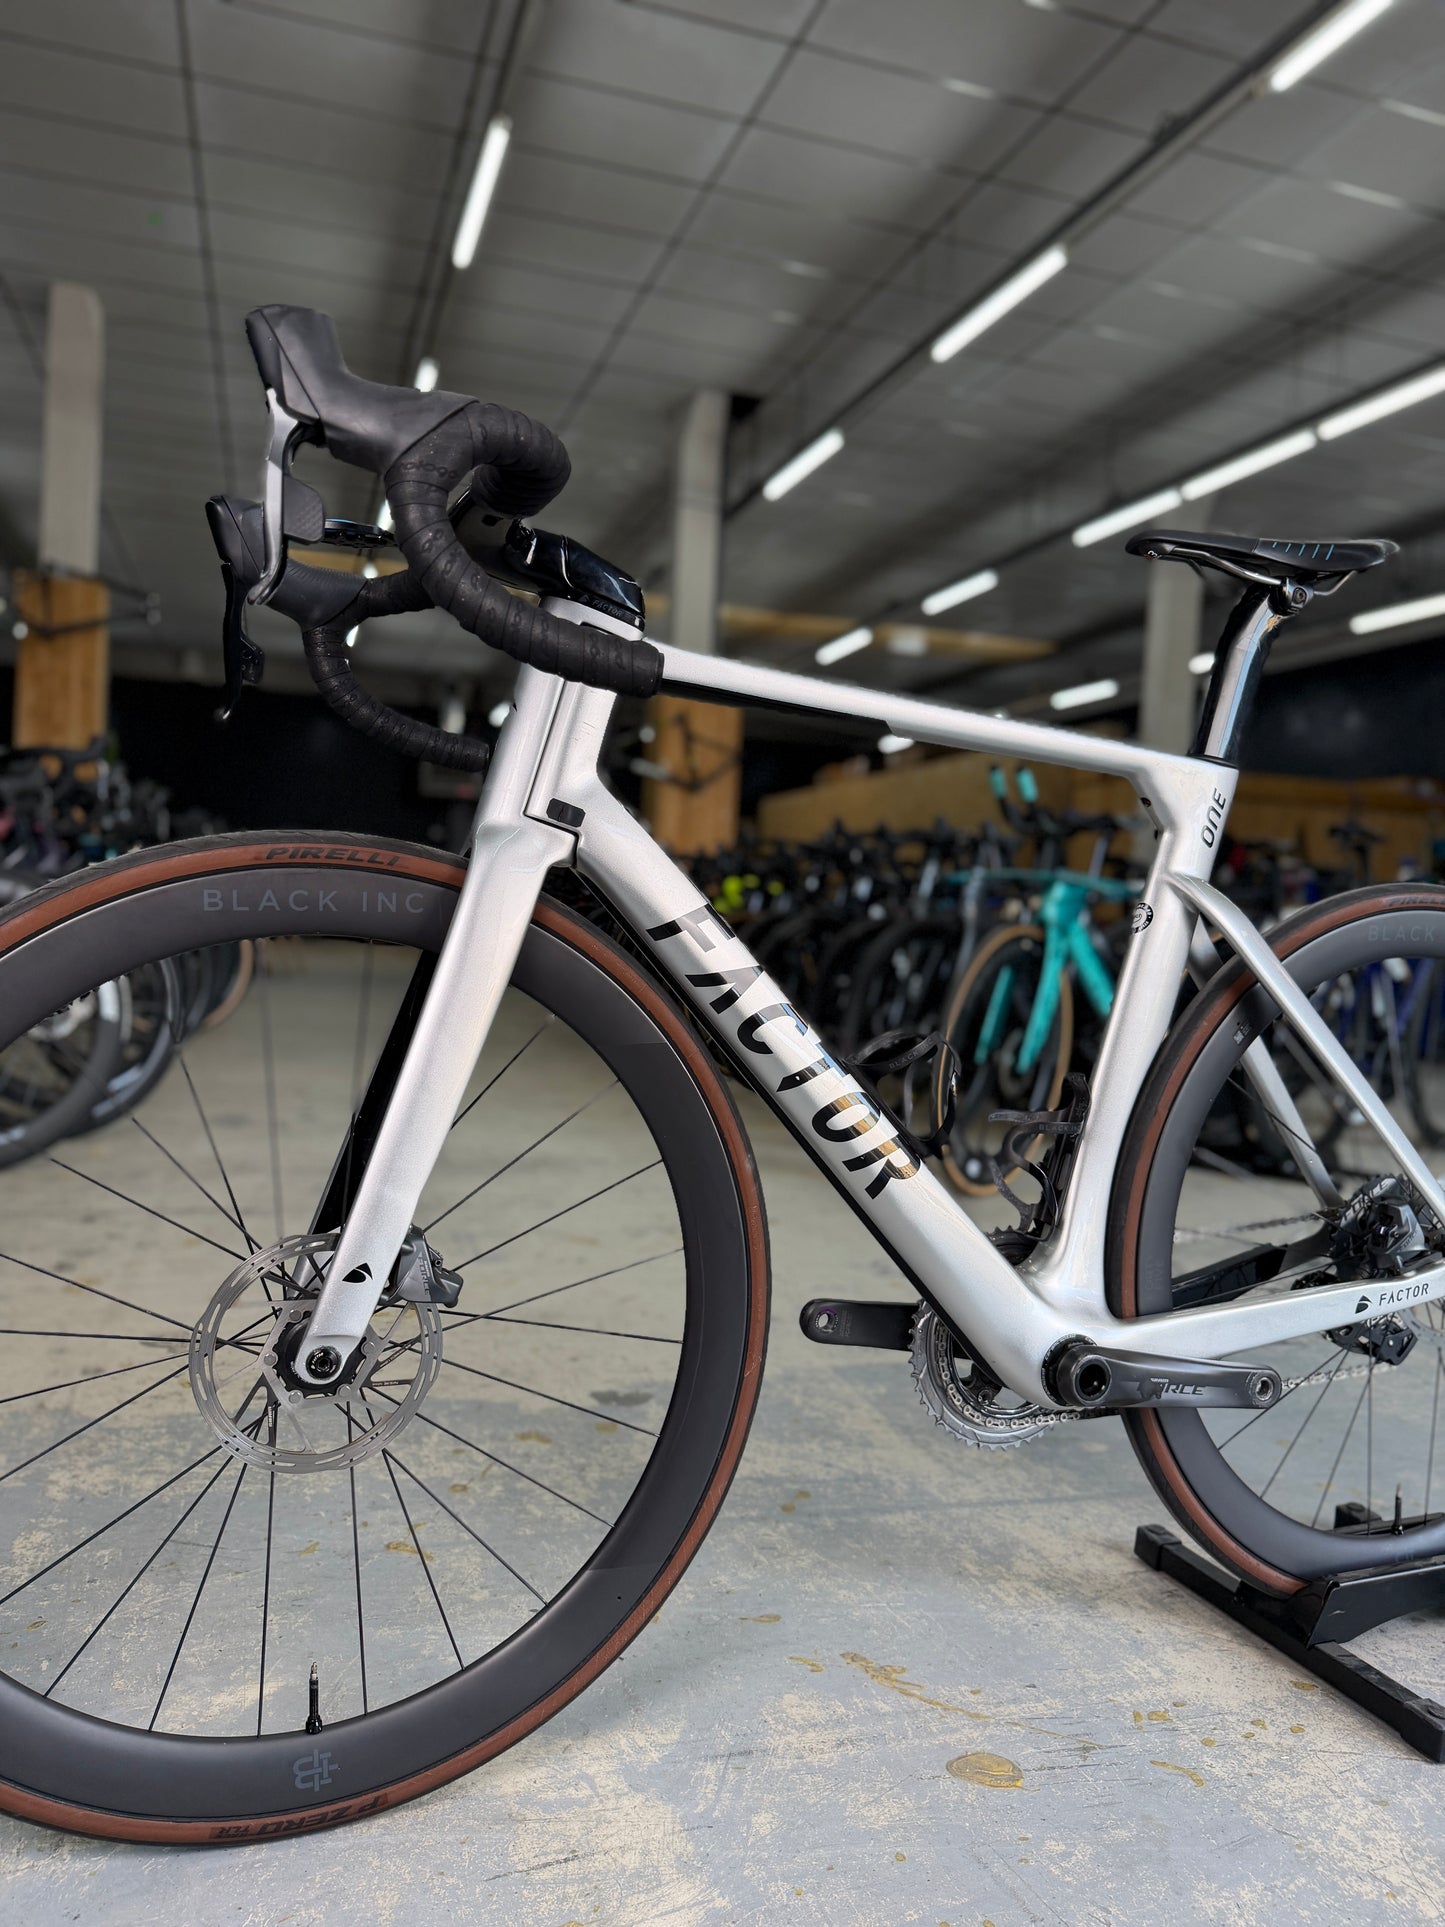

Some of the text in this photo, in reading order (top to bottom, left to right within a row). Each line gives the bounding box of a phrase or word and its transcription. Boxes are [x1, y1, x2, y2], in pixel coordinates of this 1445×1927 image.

[591, 599, 624, 617] FACTOR
[1201, 788, 1226, 848] ONE
[266, 847, 401, 866] PIRELLI
[203, 889, 425, 913] BLACK INC
[1368, 926, 1435, 941] BLACK
[646, 902, 921, 1199] FACTOR
[1379, 1283, 1429, 1306] FACTOR
[256, 1805, 352, 1835] ZERO
